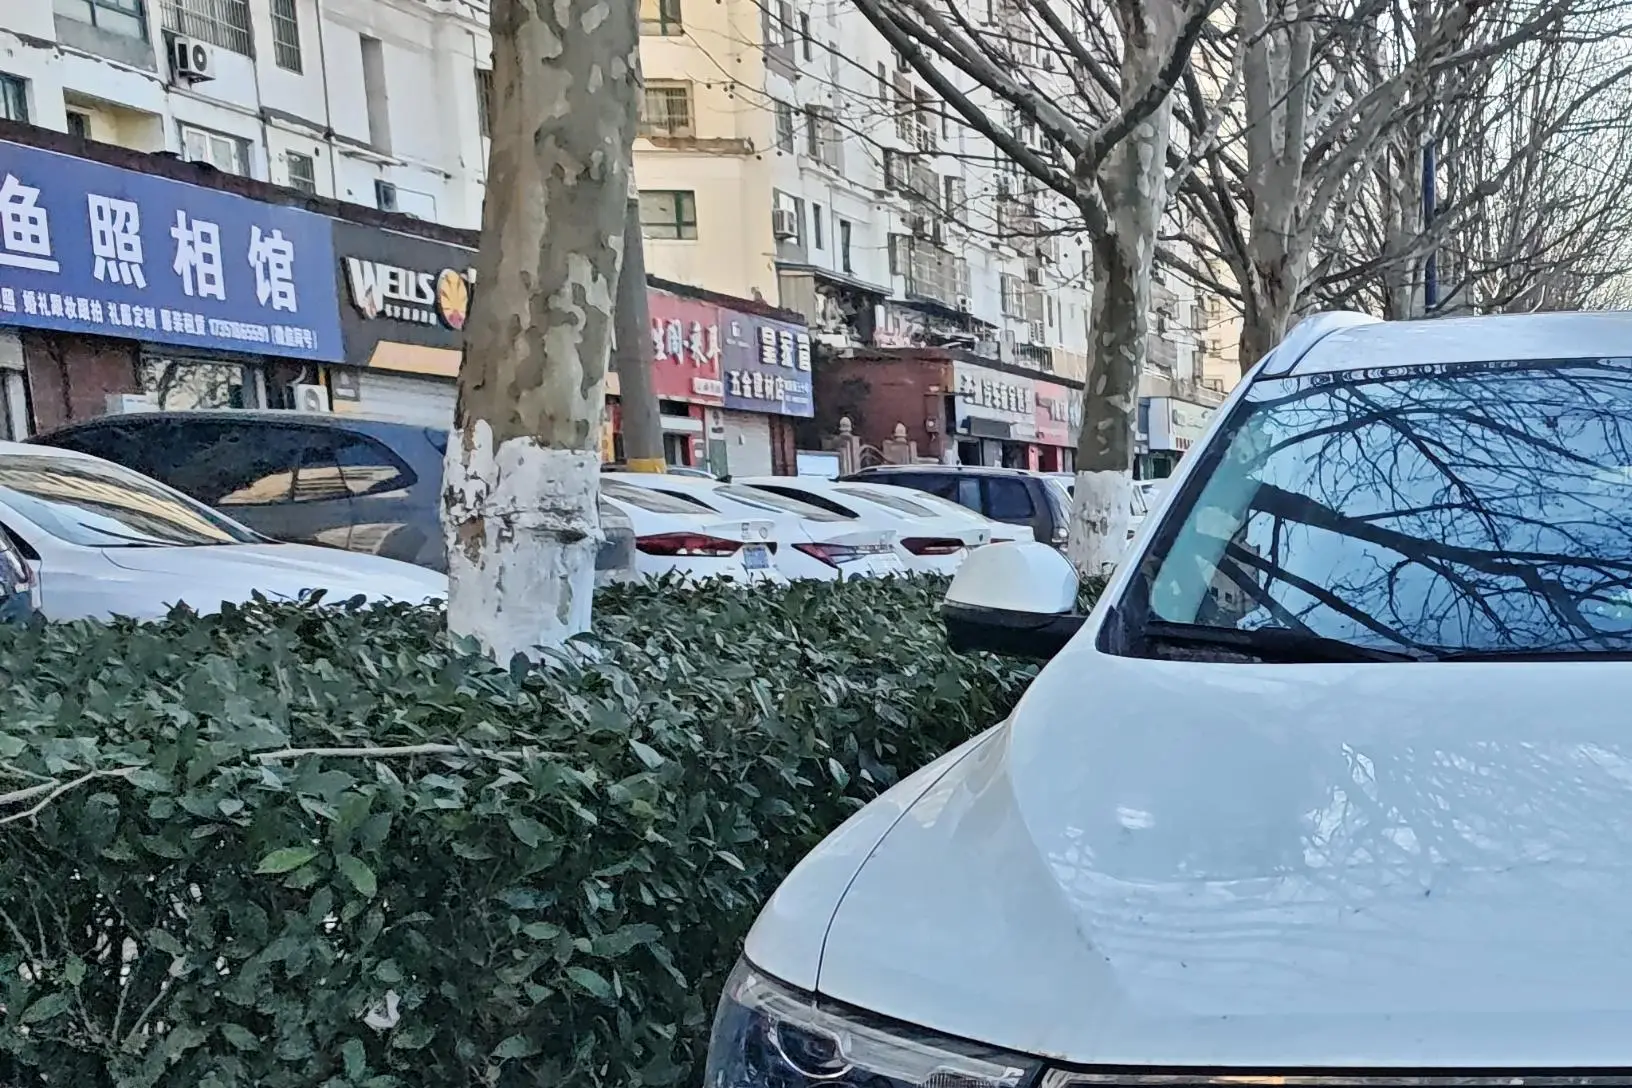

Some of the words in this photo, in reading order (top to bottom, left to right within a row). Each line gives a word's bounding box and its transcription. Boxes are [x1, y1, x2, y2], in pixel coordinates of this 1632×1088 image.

[0, 173, 298, 313] 鱼照相馆
[730, 370, 785, 400] 五金建材店
